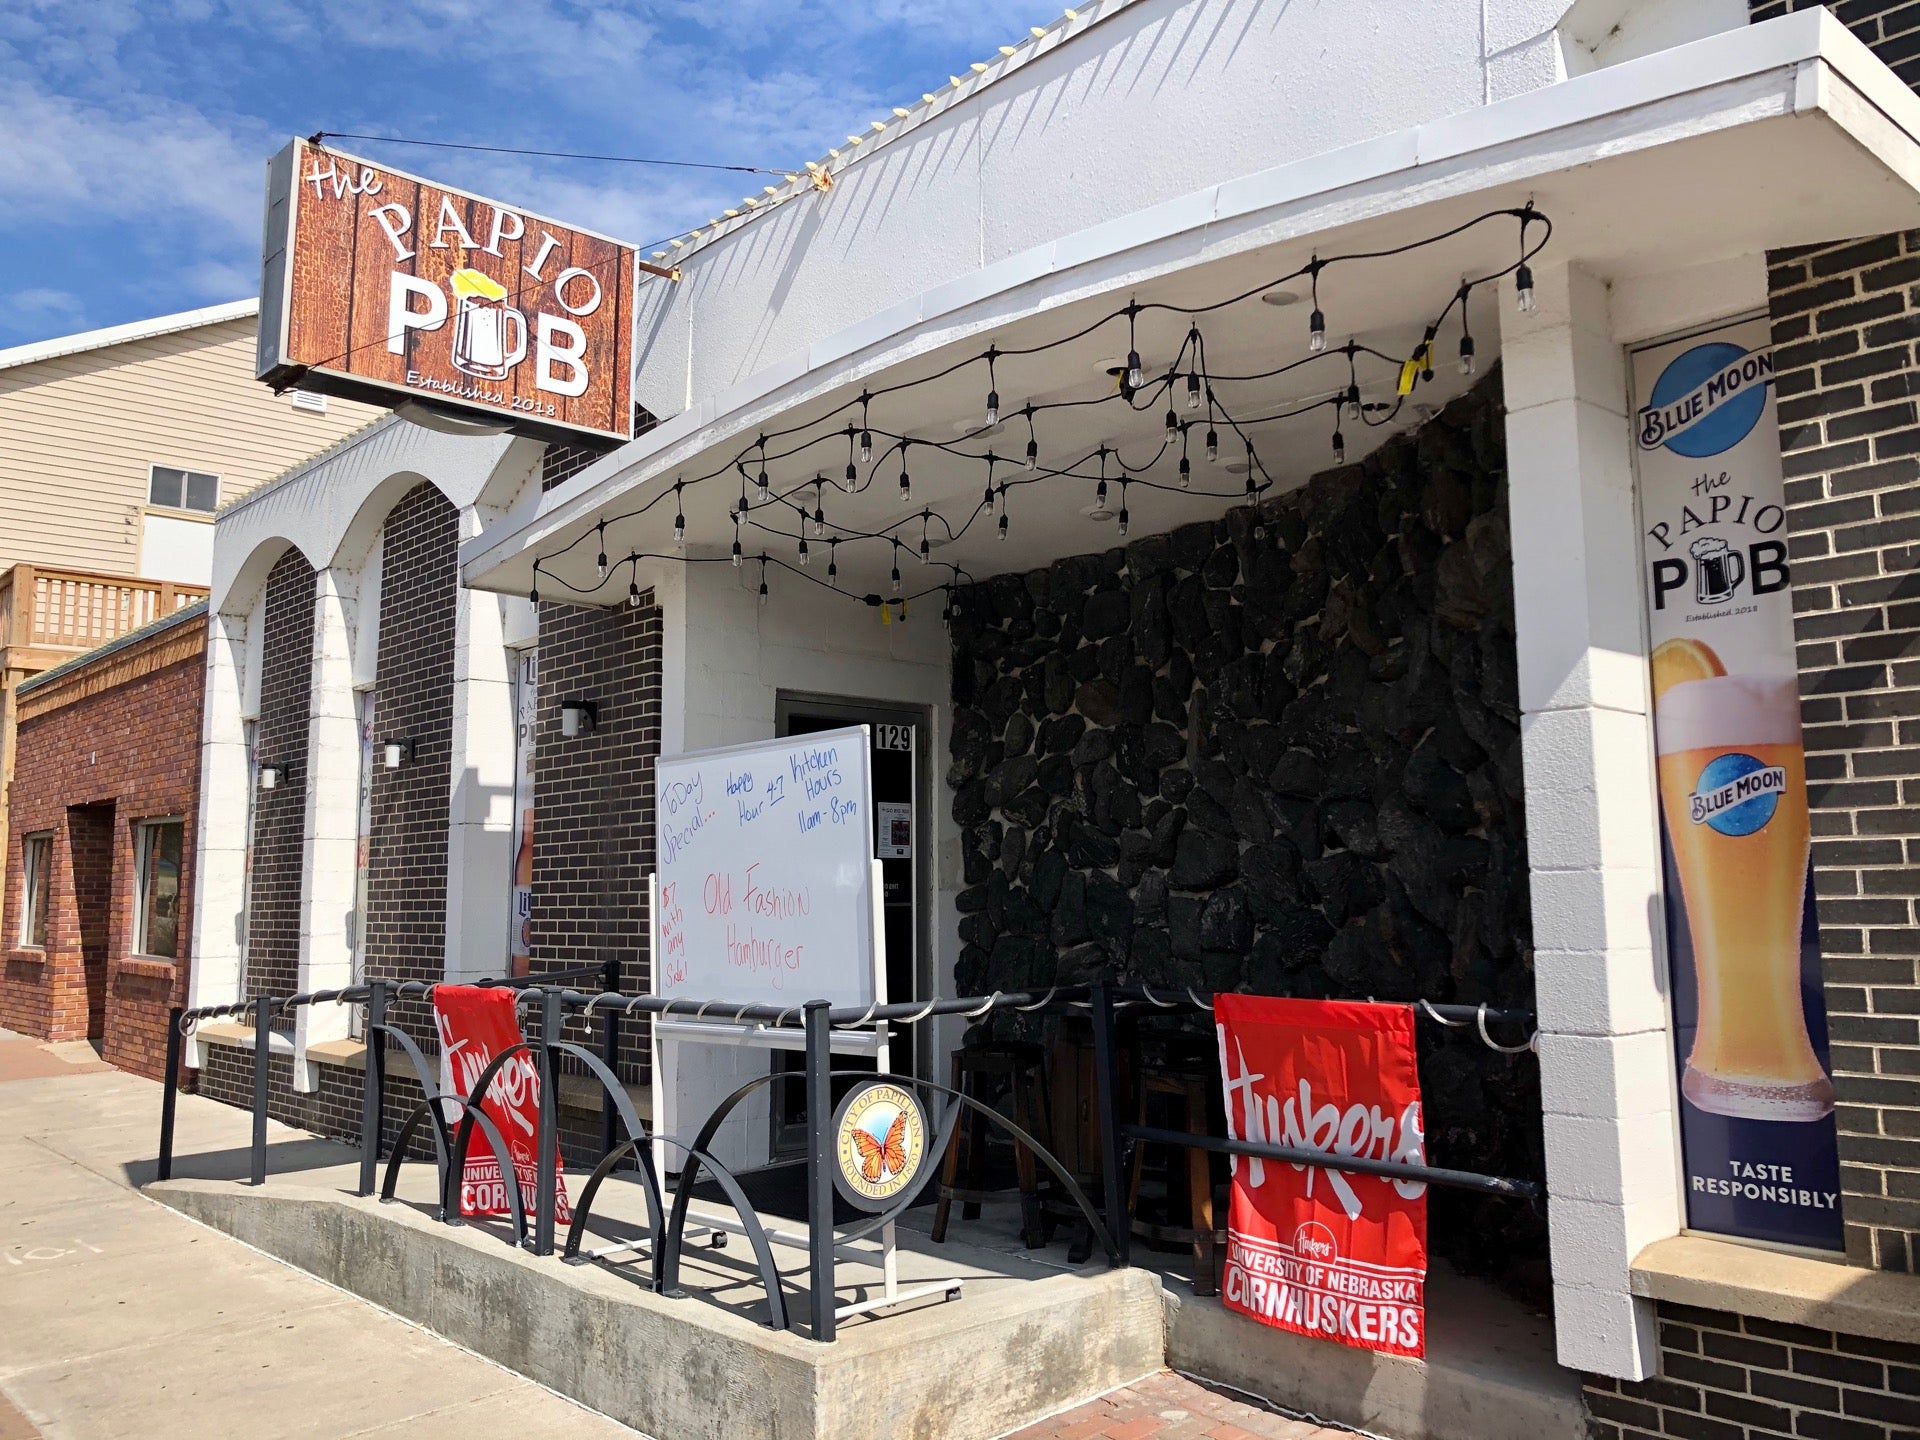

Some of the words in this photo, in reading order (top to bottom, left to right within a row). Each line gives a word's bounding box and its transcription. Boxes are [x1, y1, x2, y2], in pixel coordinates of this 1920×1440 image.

[306, 157, 383, 201] the
[368, 195, 602, 316] PAPIO
[407, 370, 505, 405] Established
[512, 396, 555, 416] 2018
[1642, 393, 1703, 445] BLUE
[1707, 352, 1773, 407] MOON
[1691, 471, 1731, 497] the
[1648, 495, 1785, 551] PAPIO
[1686, 608, 1732, 622] Established
[1735, 605, 1758, 615] 2018
[878, 725, 910, 749] 129
[790, 747, 838, 783] Kitchen
[726, 771, 753, 797] Happy
[805, 769, 842, 801] Hours
[1692, 788, 1733, 821] BLUE
[1736, 771, 1783, 799] MOON
[738, 800, 764, 826] Hour
[704, 872, 732, 914] Old
[662, 904, 683, 937] with
[668, 931, 684, 956] any
[727, 923, 803, 990] Hamburger
[841, 1111, 858, 1145] CITY
[859, 1092, 874, 1109] OF
[877, 1090, 921, 1138] PAPILLION
[843, 1159, 887, 1196] FOUNDED
[889, 1179, 902, 1193] IN
[903, 1153, 918, 1182] 1870
[1729, 1161, 1793, 1183] TASTE
[1692, 1176, 1837, 1209] RESPONSIBLY
[1305, 1266, 1324, 1286] OF
[1328, 1270, 1417, 1302] NEBRASKA
[1227, 1266, 1419, 1348] CORNHUSKERS
